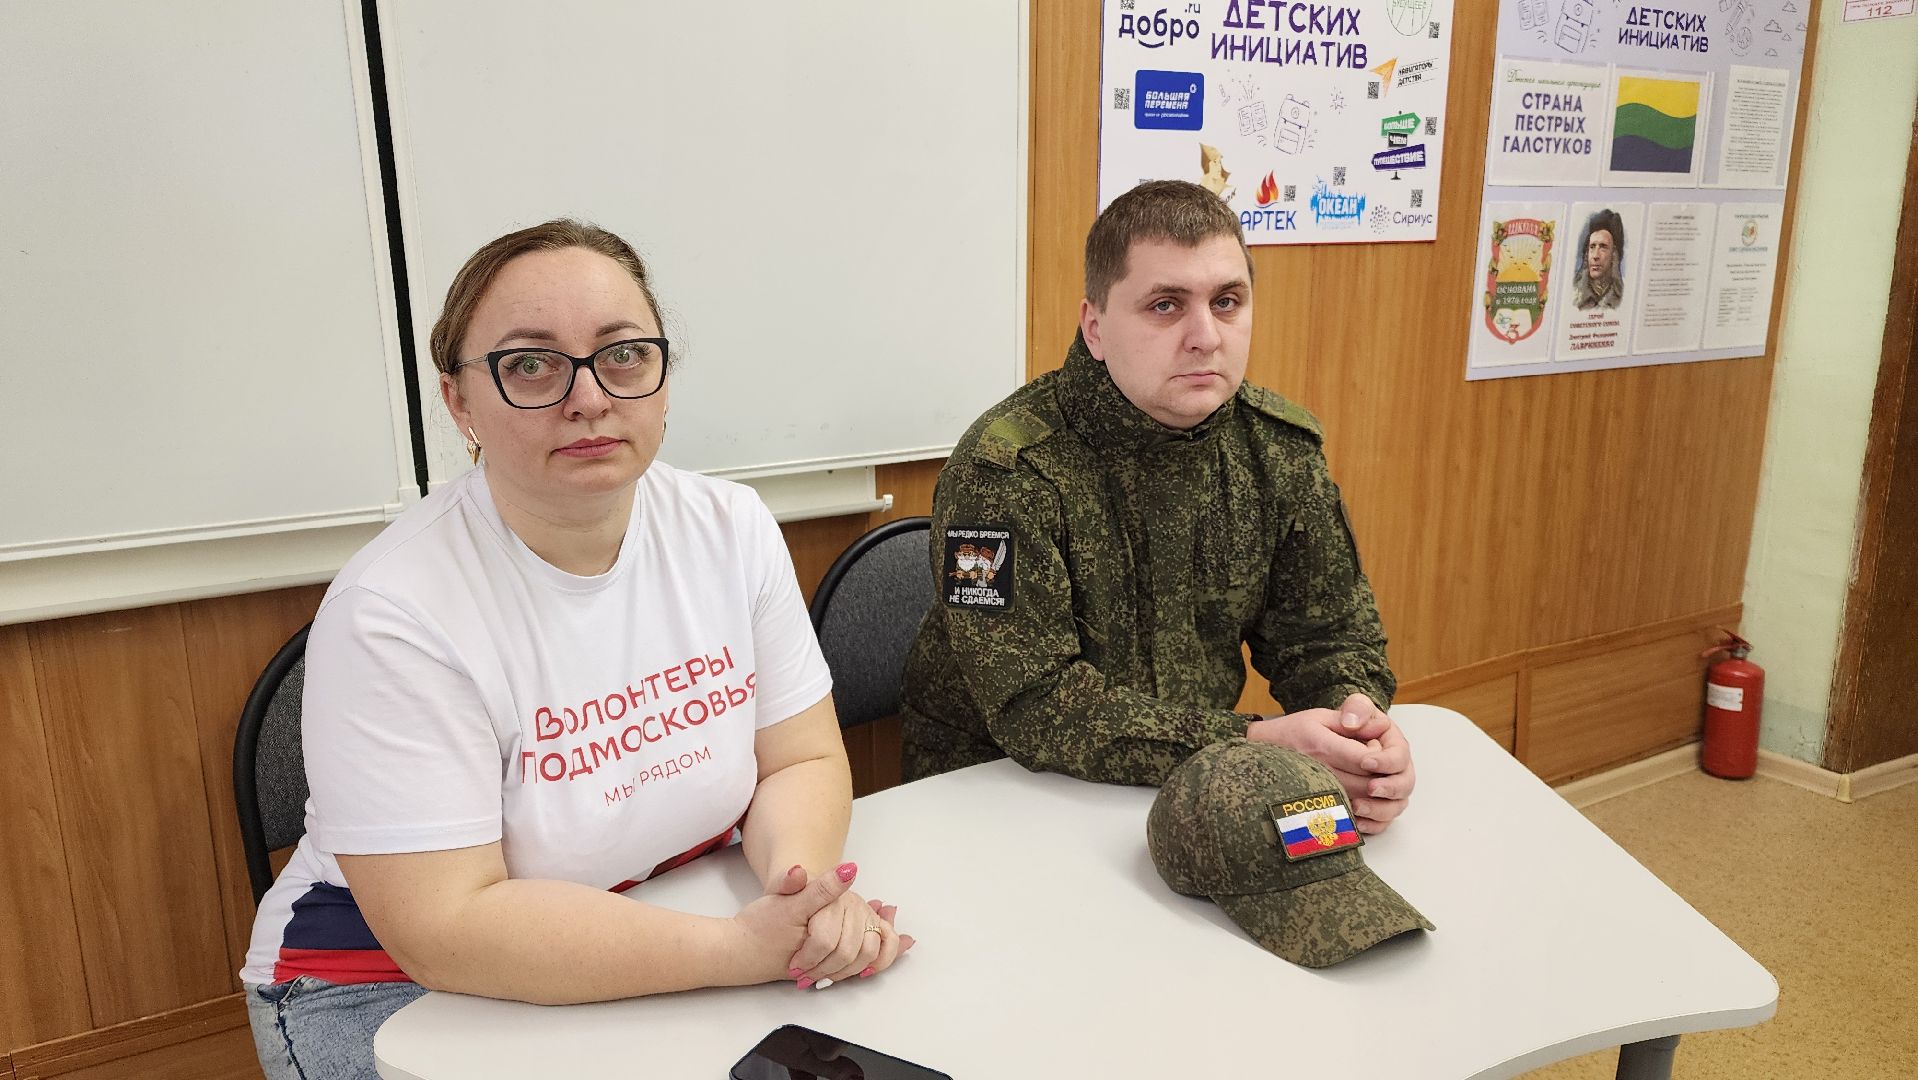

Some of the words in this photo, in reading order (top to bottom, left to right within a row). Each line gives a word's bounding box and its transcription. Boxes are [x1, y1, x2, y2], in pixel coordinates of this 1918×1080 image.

[1223, 0, 1361, 36] ДЕТСКИХ
[1626, 7, 1707, 32] ДЕТСКИХ
[1866, 5, 1893, 17] 112
[1211, 32, 1368, 69] ИНИЦИАТИВ
[1618, 28, 1709, 53] ИНИЦИАТИВ
[1144, 100, 1189, 110] ПЕРЕМЕНА
[1145, 91, 1190, 101] БОЛЬШАЯ
[1522, 92, 1583, 112] СТРАНА
[1515, 114, 1585, 134] ПЕСТРЫХ
[1503, 136, 1592, 155] ГАЛСТУКОВ
[1318, 198, 1358, 216] ОКЕАН
[1241, 209, 1297, 232] АРТЕК
[1393, 211, 1433, 227] Сириус
[958, 530, 978, 538] РЕДКО
[979, 531, 1009, 539] БРЕЕМСЯ
[949, 595, 960, 604] НЕ
[954, 586, 961, 595] И
[961, 587, 999, 597] НИКОГДА
[535, 646, 735, 742] ВОЛОНТЕРЫ
[521, 671, 756, 784] ПОДМОСКОВЬЯ
[604, 777, 636, 807] МЫ
[639, 746, 712, 787] РЯДОМ
[1283, 794, 1338, 816] РОССИЯ
